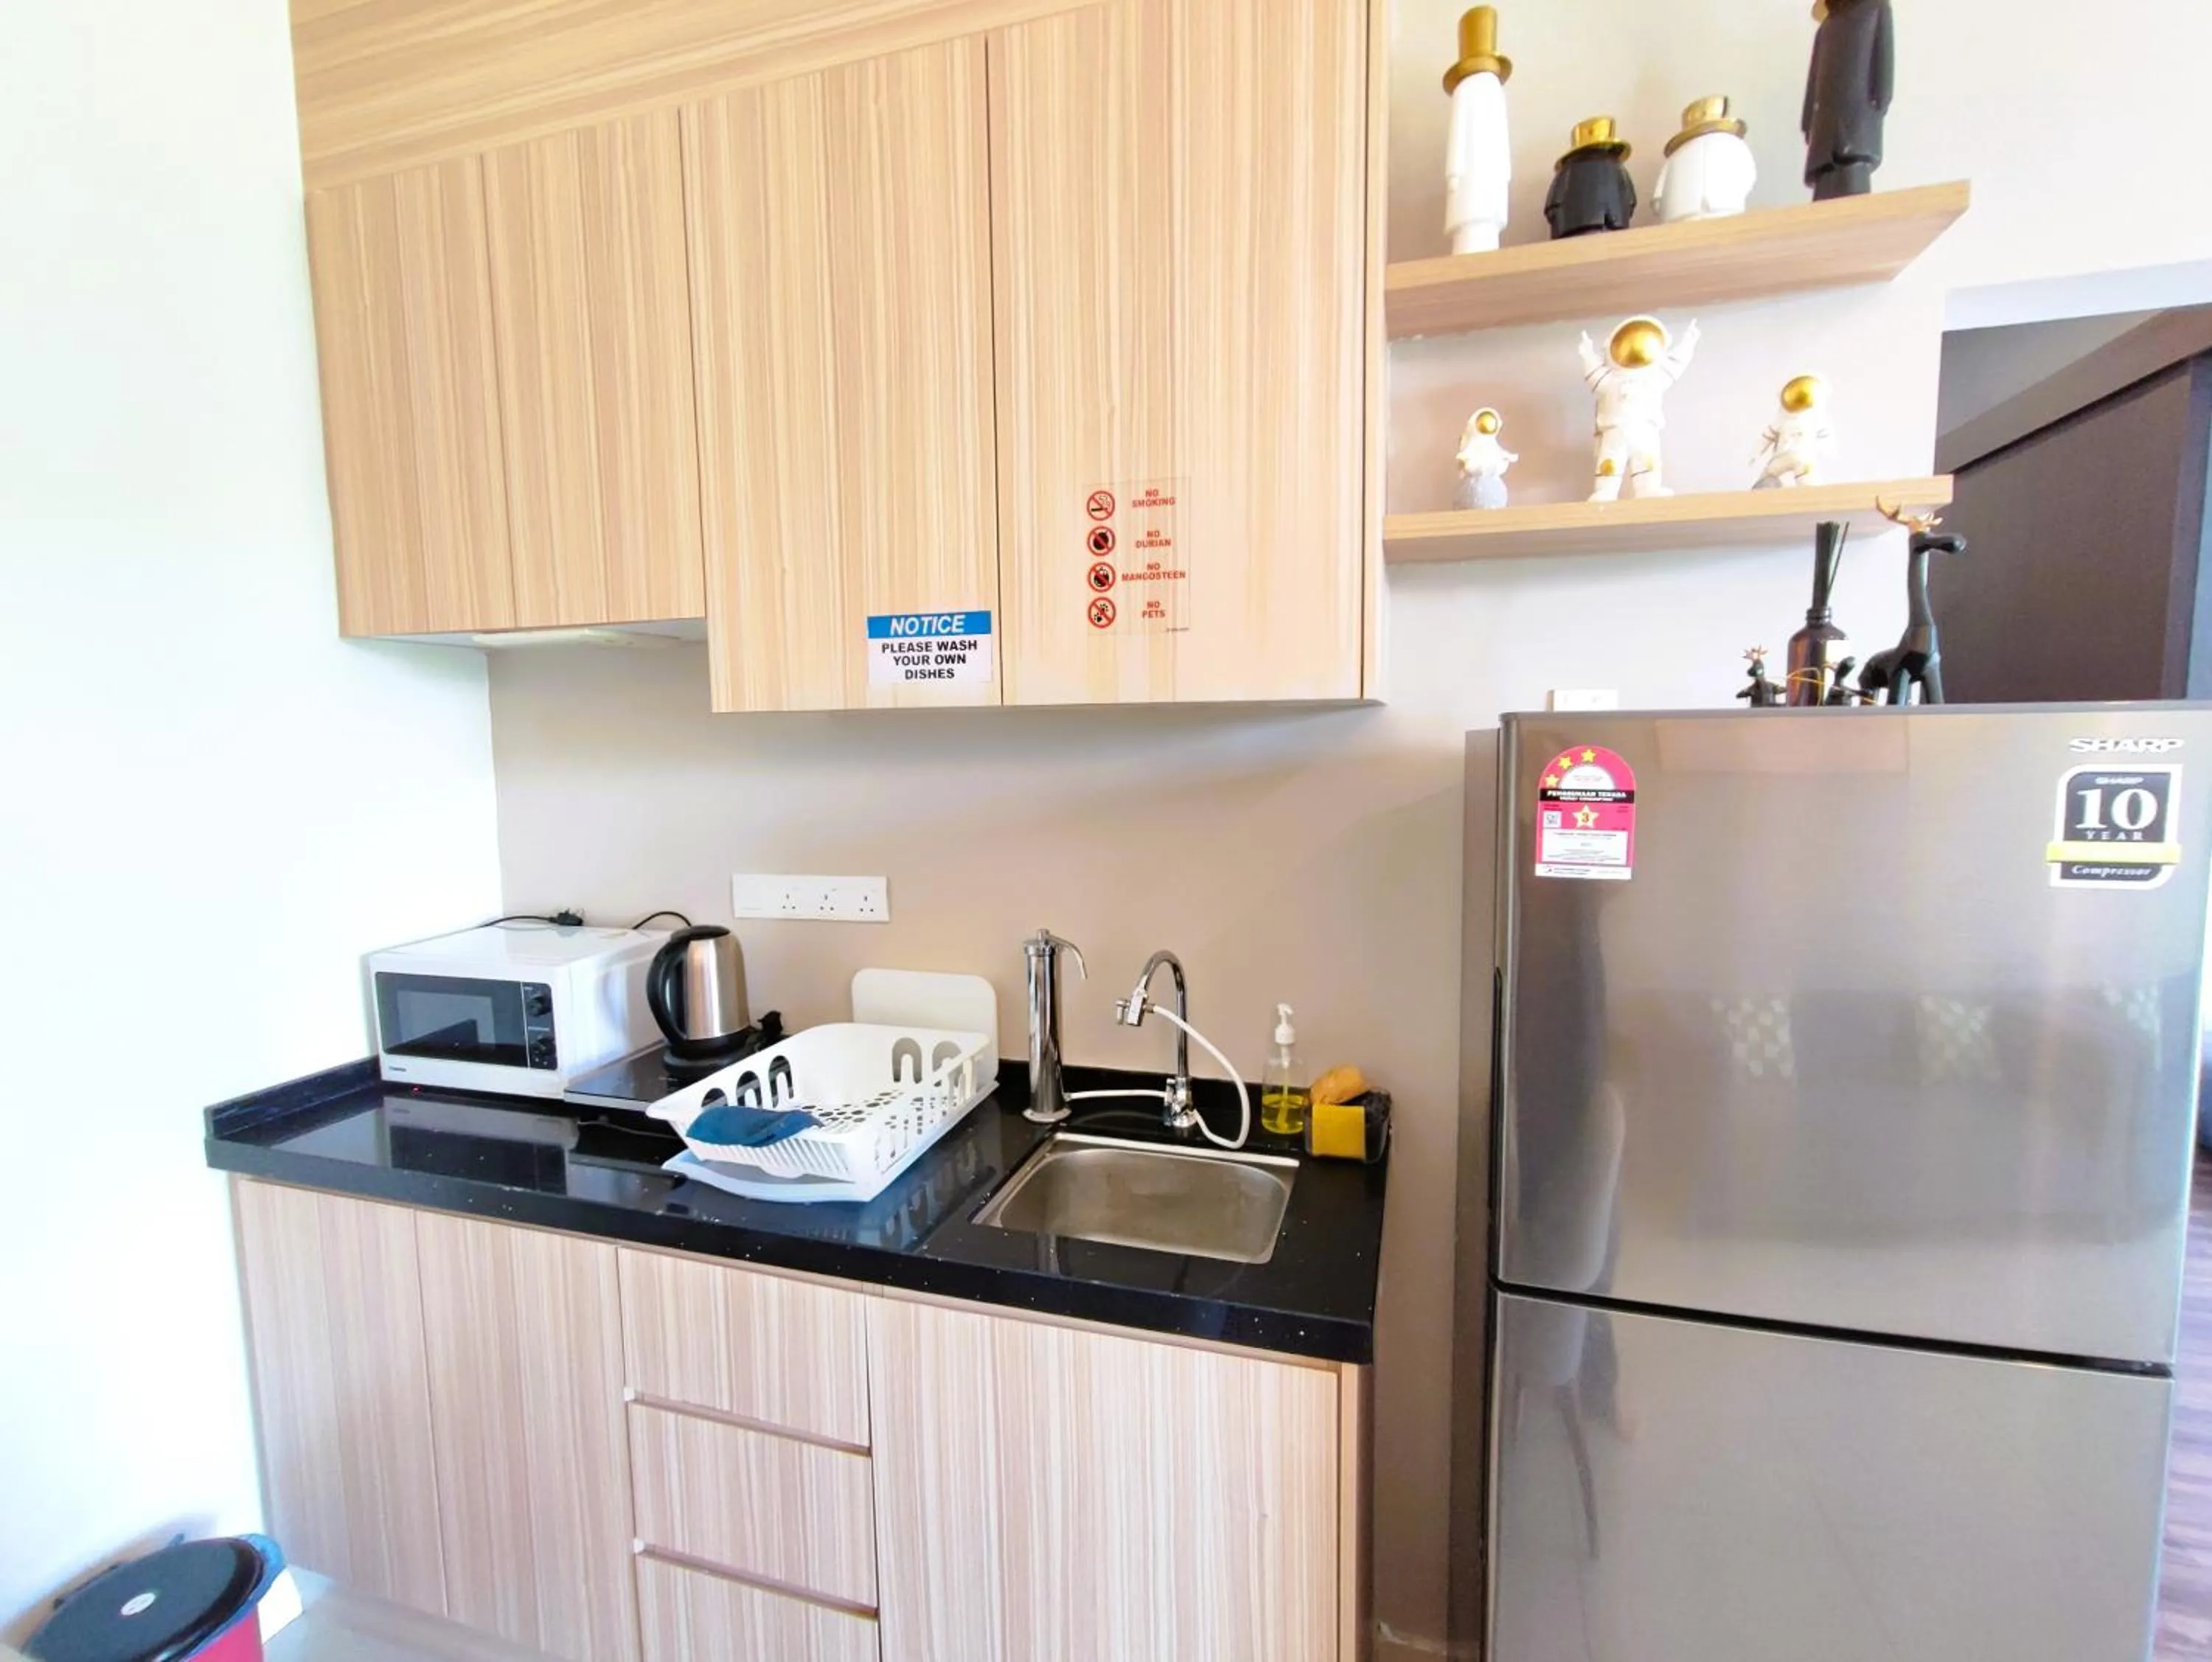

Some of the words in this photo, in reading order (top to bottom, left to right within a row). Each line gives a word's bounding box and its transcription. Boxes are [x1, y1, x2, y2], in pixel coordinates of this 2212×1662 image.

[1145, 489, 1159, 497] NO
[1132, 497, 1175, 507] SMOKING
[1135, 539, 1172, 549] DURIAN
[1121, 571, 1186, 582] MANGOSTEEN
[1142, 610, 1165, 619] PETS
[890, 615, 966, 636] NOTICE
[882, 641, 933, 653] PLEASE
[937, 640, 978, 651] WASH
[894, 655, 930, 666] YOUR
[935, 654, 966, 664] OWN
[905, 668, 955, 680] DISHES
[2068, 738, 2185, 753] SHARP
[2075, 788, 2159, 830] 10
[2086, 831, 2143, 841] YEAR
[2071, 864, 2152, 877] Compressor
